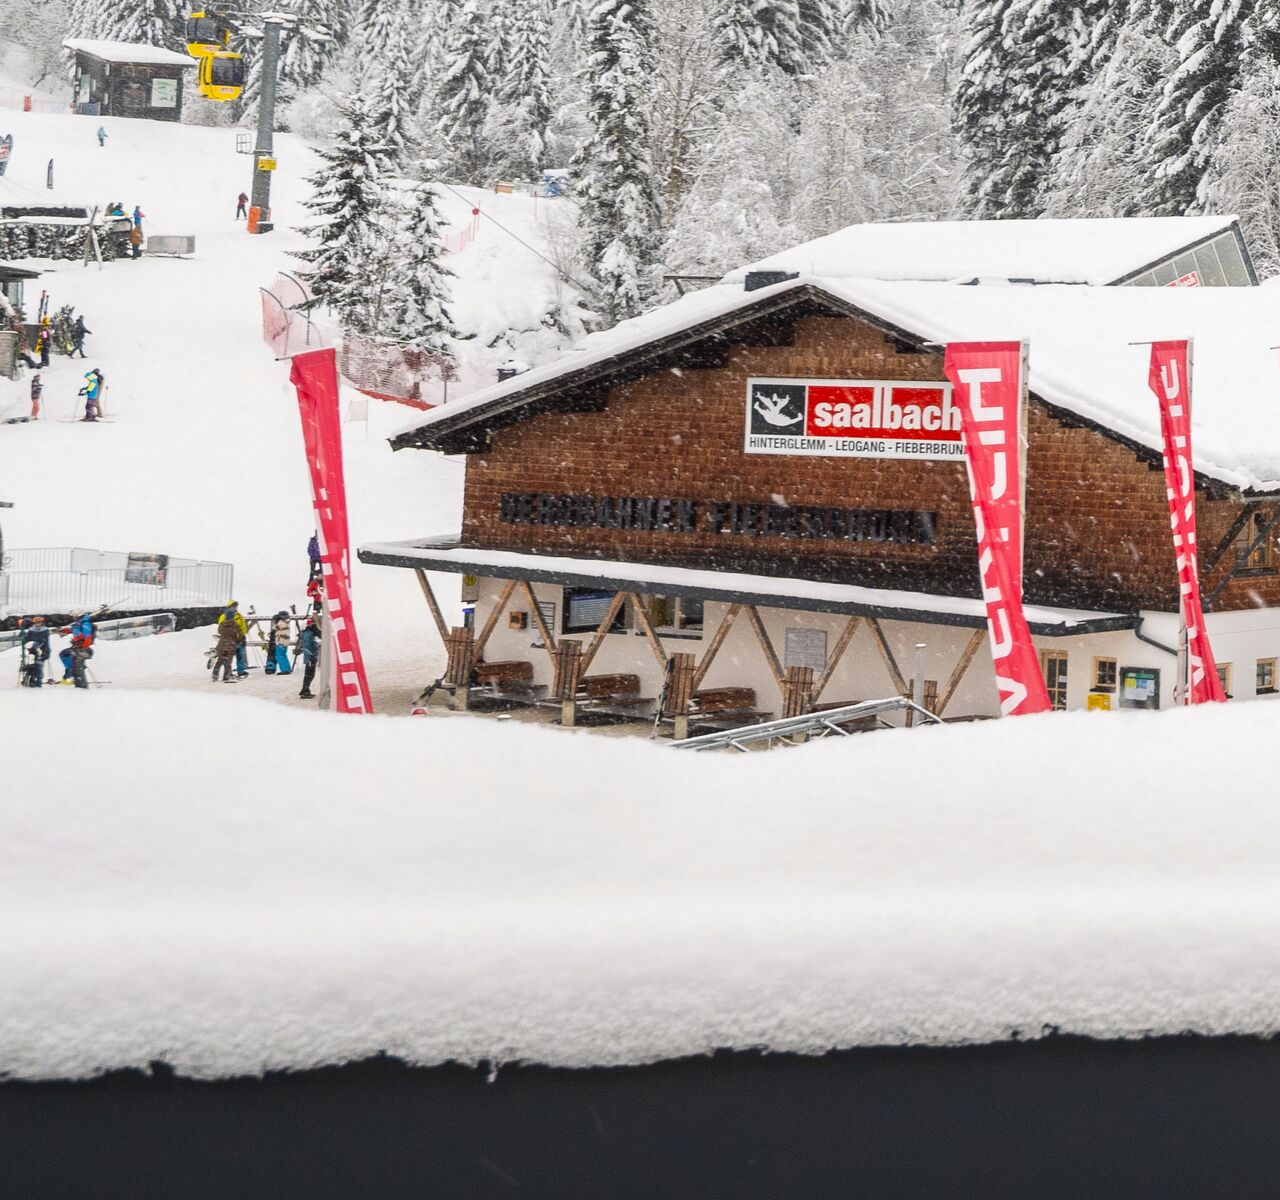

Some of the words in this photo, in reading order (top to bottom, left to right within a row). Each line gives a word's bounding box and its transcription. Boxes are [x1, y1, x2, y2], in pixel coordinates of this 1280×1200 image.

[813, 386, 962, 432] saalbach
[749, 437, 826, 451] HINTERGLEMM
[835, 440, 886, 453] LEOGANG
[895, 441, 967, 455] FIEBERBRUN
